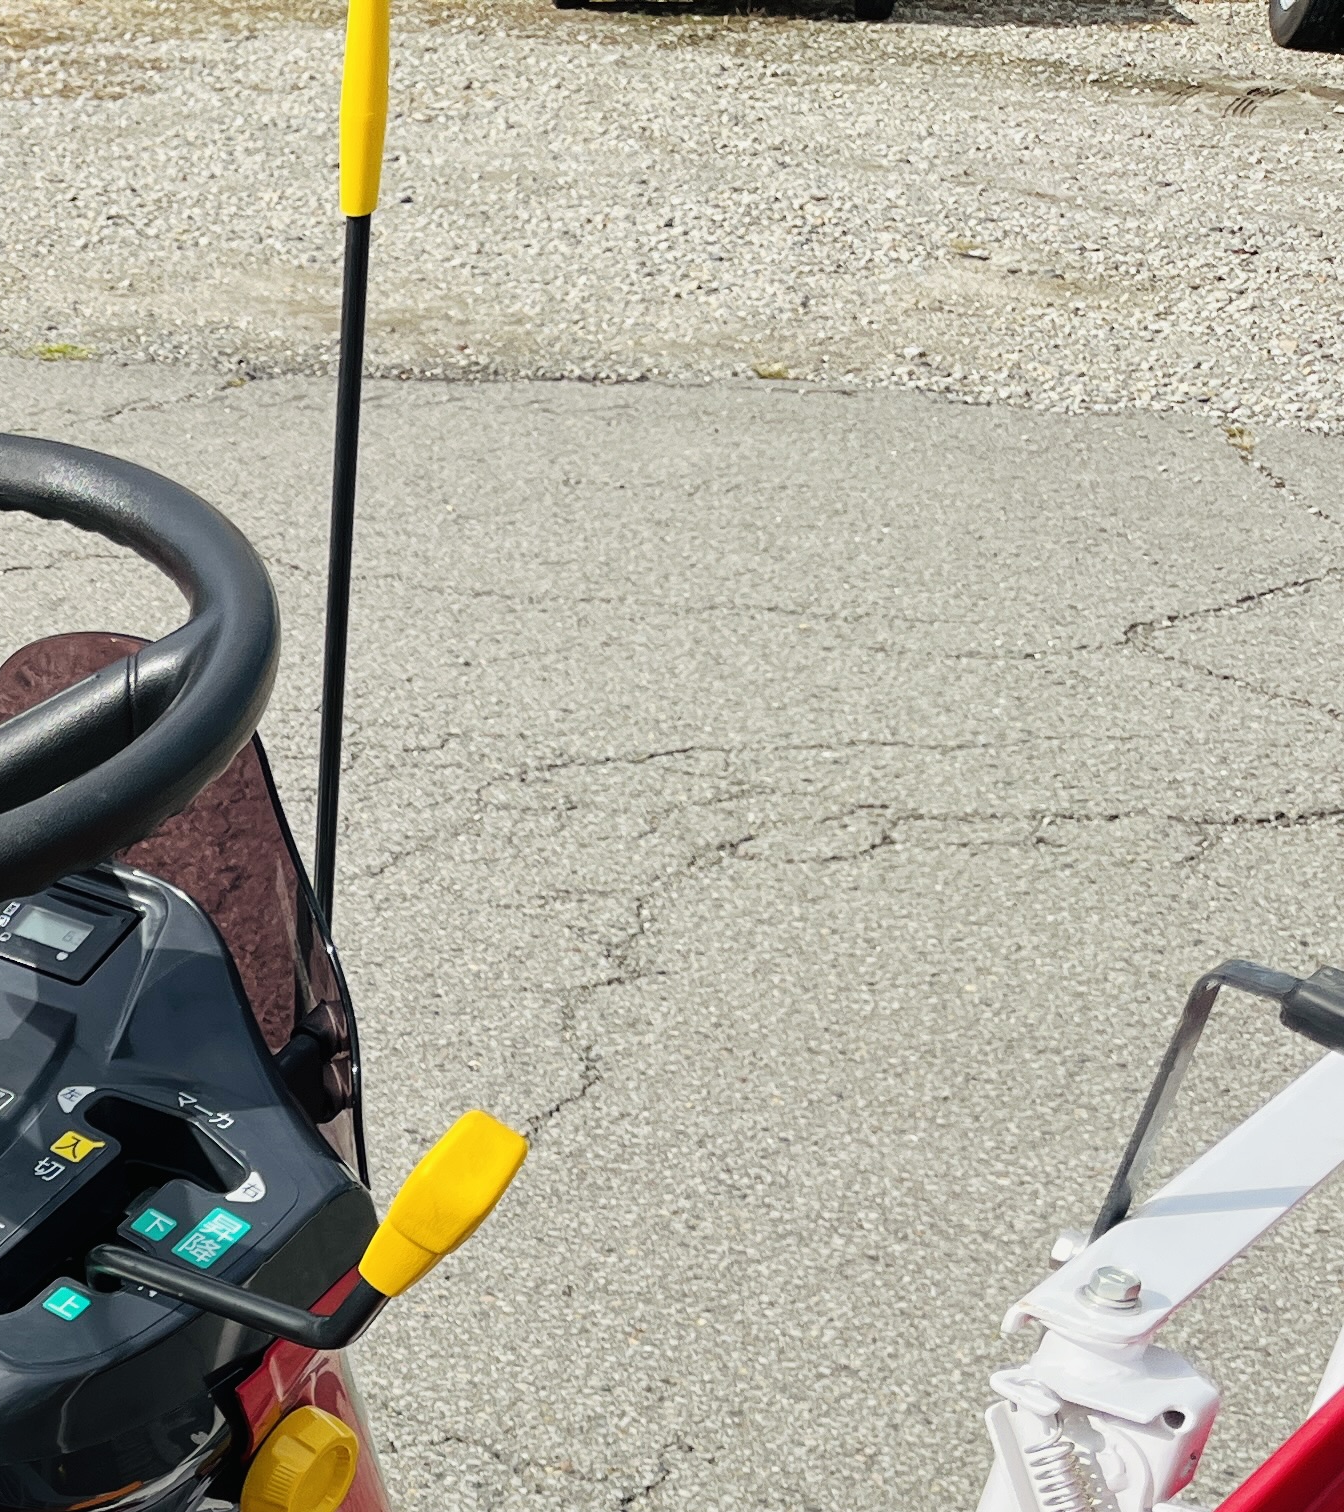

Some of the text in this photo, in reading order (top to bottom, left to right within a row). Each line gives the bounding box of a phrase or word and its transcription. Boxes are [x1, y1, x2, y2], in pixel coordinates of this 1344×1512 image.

[60, 1086, 84, 1104] 左
[177, 1091, 235, 1130] マーカ
[54, 1135, 81, 1159] 入
[33, 1156, 66, 1182] 切
[241, 1181, 263, 1199] 右
[144, 1210, 176, 1233] 下
[177, 1213, 243, 1263] 昇降
[48, 1295, 79, 1318] 上
